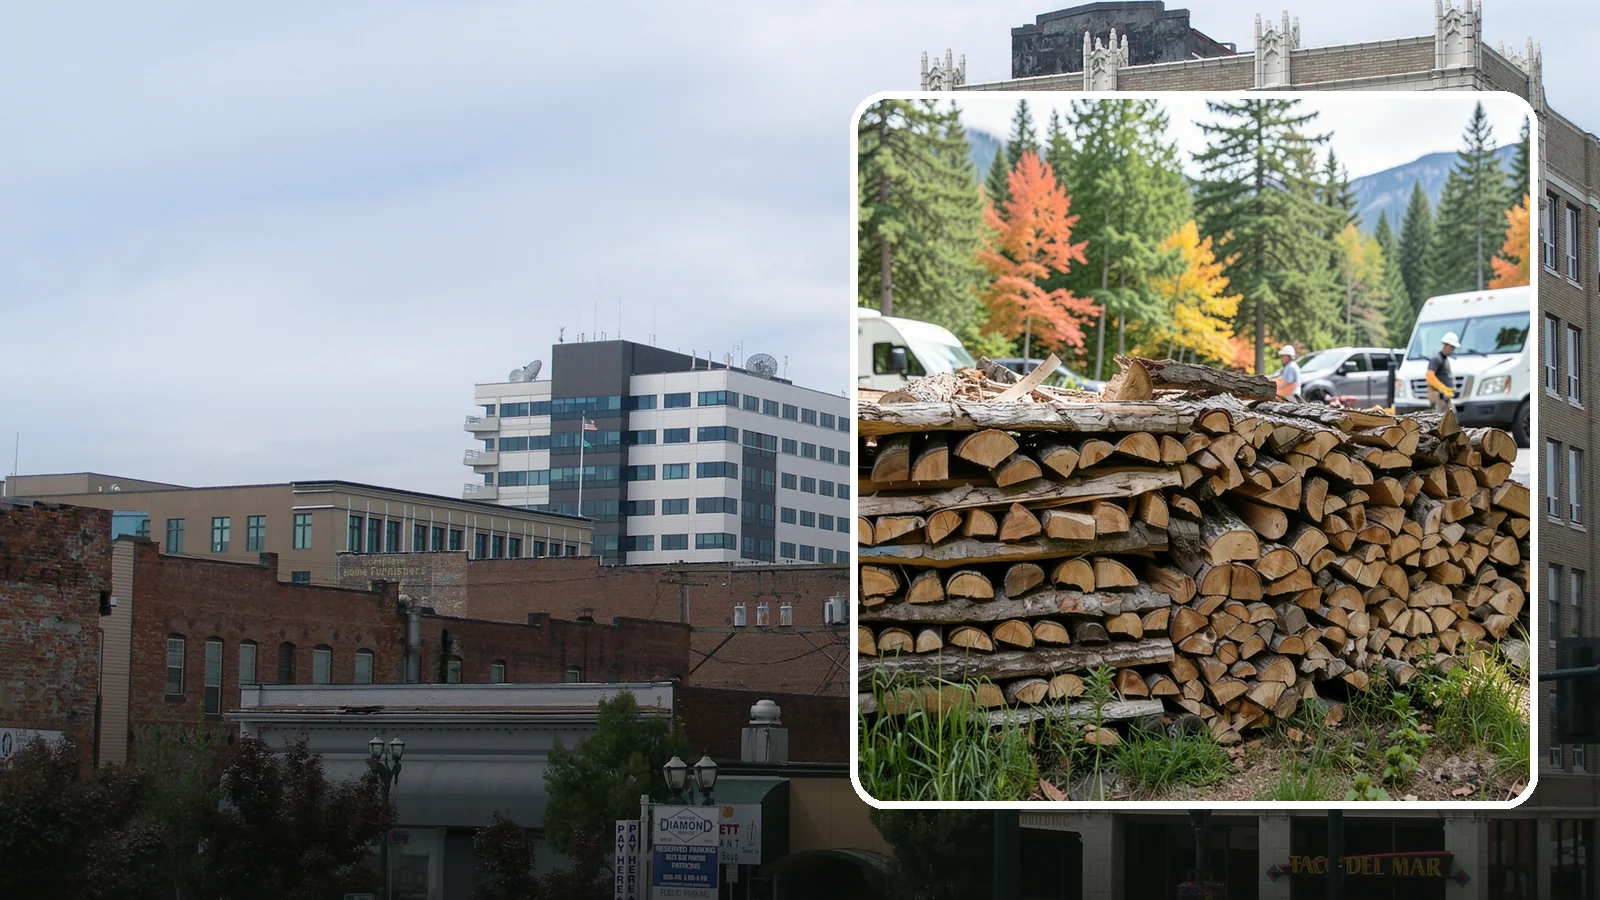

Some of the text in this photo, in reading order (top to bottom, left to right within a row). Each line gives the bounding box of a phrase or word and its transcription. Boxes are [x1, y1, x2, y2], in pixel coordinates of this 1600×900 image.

[343, 566, 427, 577] Home Furnishers
[660, 818, 713, 833] DIAMOND
[1022, 816, 1070, 827] BUILDING
[655, 845, 716, 854] RESERVED PARKING
[617, 825, 625, 894] PAY HERE
[627, 825, 637, 893] PAY HERE
[672, 862, 700, 870] PATRONS
[1345, 856, 1385, 876] DEL
[1392, 857, 1442, 877] MAR
[660, 888, 710, 898] PUBLIC PARKING
